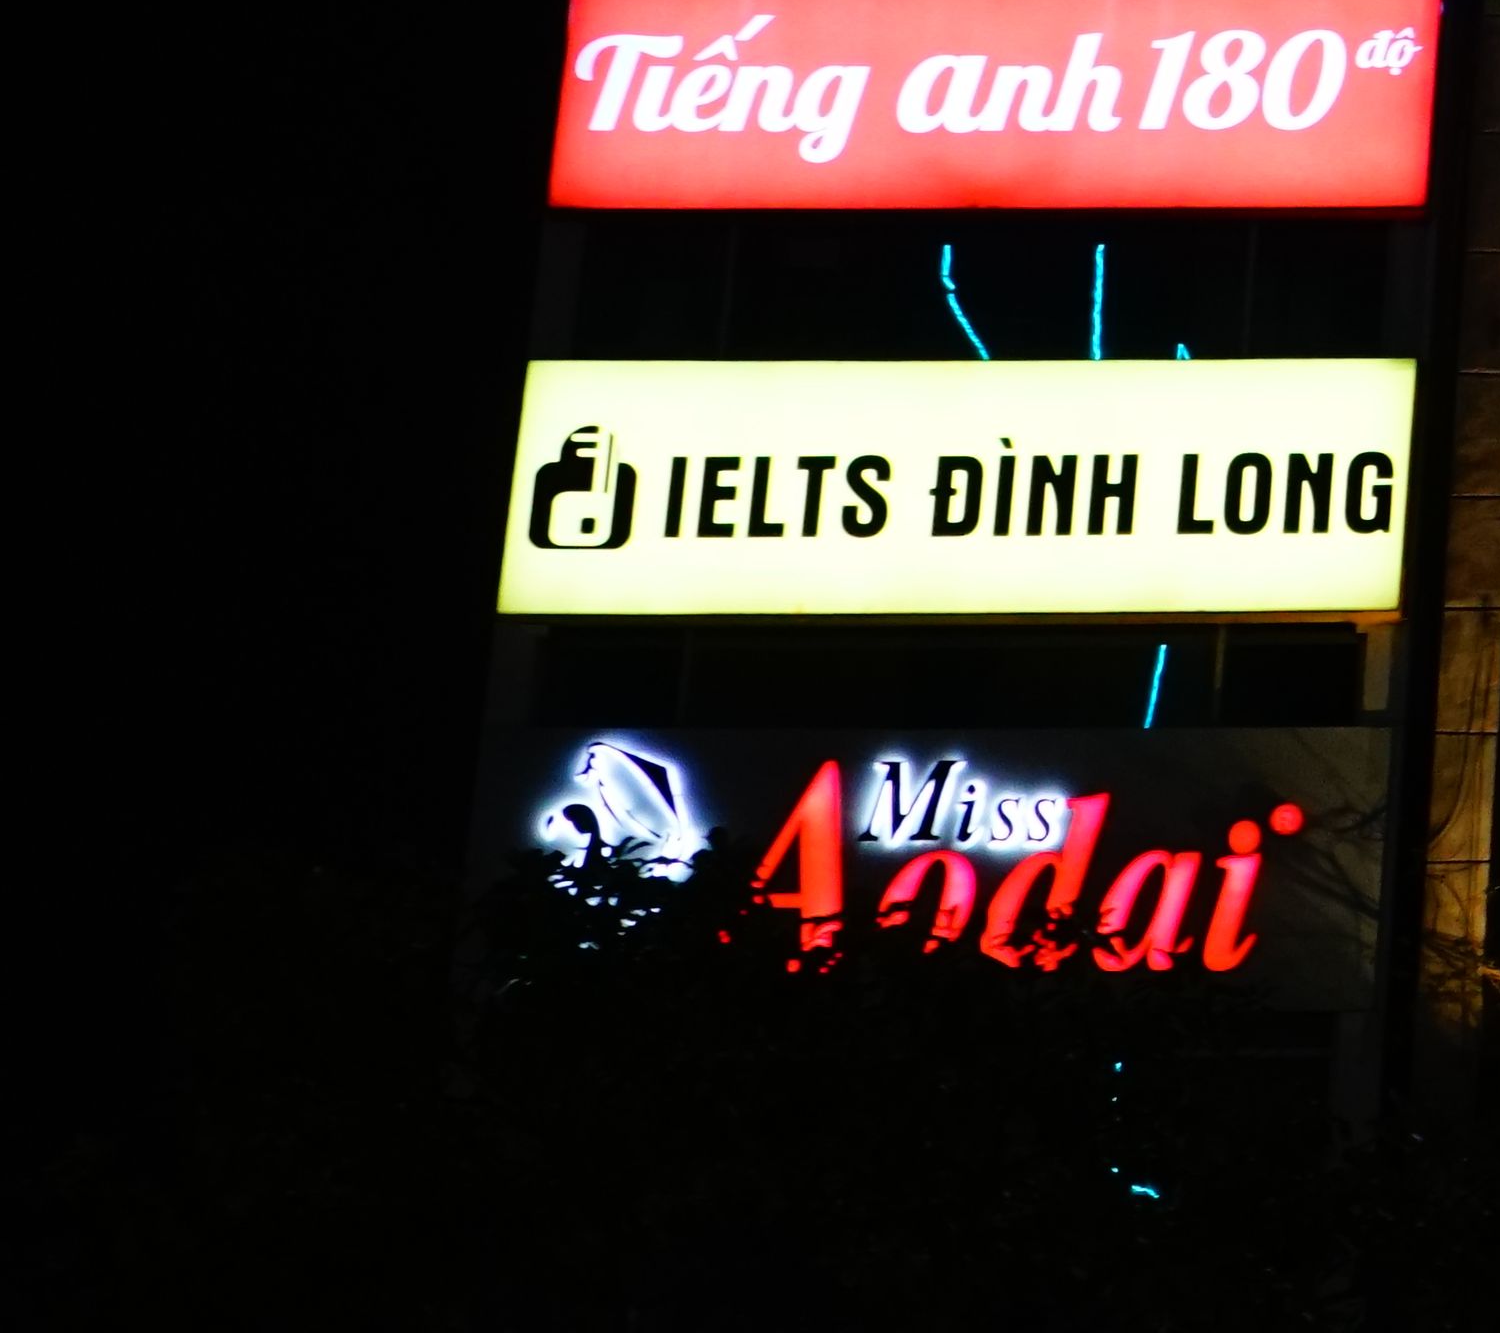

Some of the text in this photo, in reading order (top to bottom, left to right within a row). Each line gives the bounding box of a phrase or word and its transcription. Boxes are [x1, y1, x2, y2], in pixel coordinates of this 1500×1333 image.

[574, 14, 1424, 166] Tiếng anh 180 độ
[664, 437, 1393, 539] IELTS ĐÌNH LONG
[857, 758, 1064, 846] Miss
